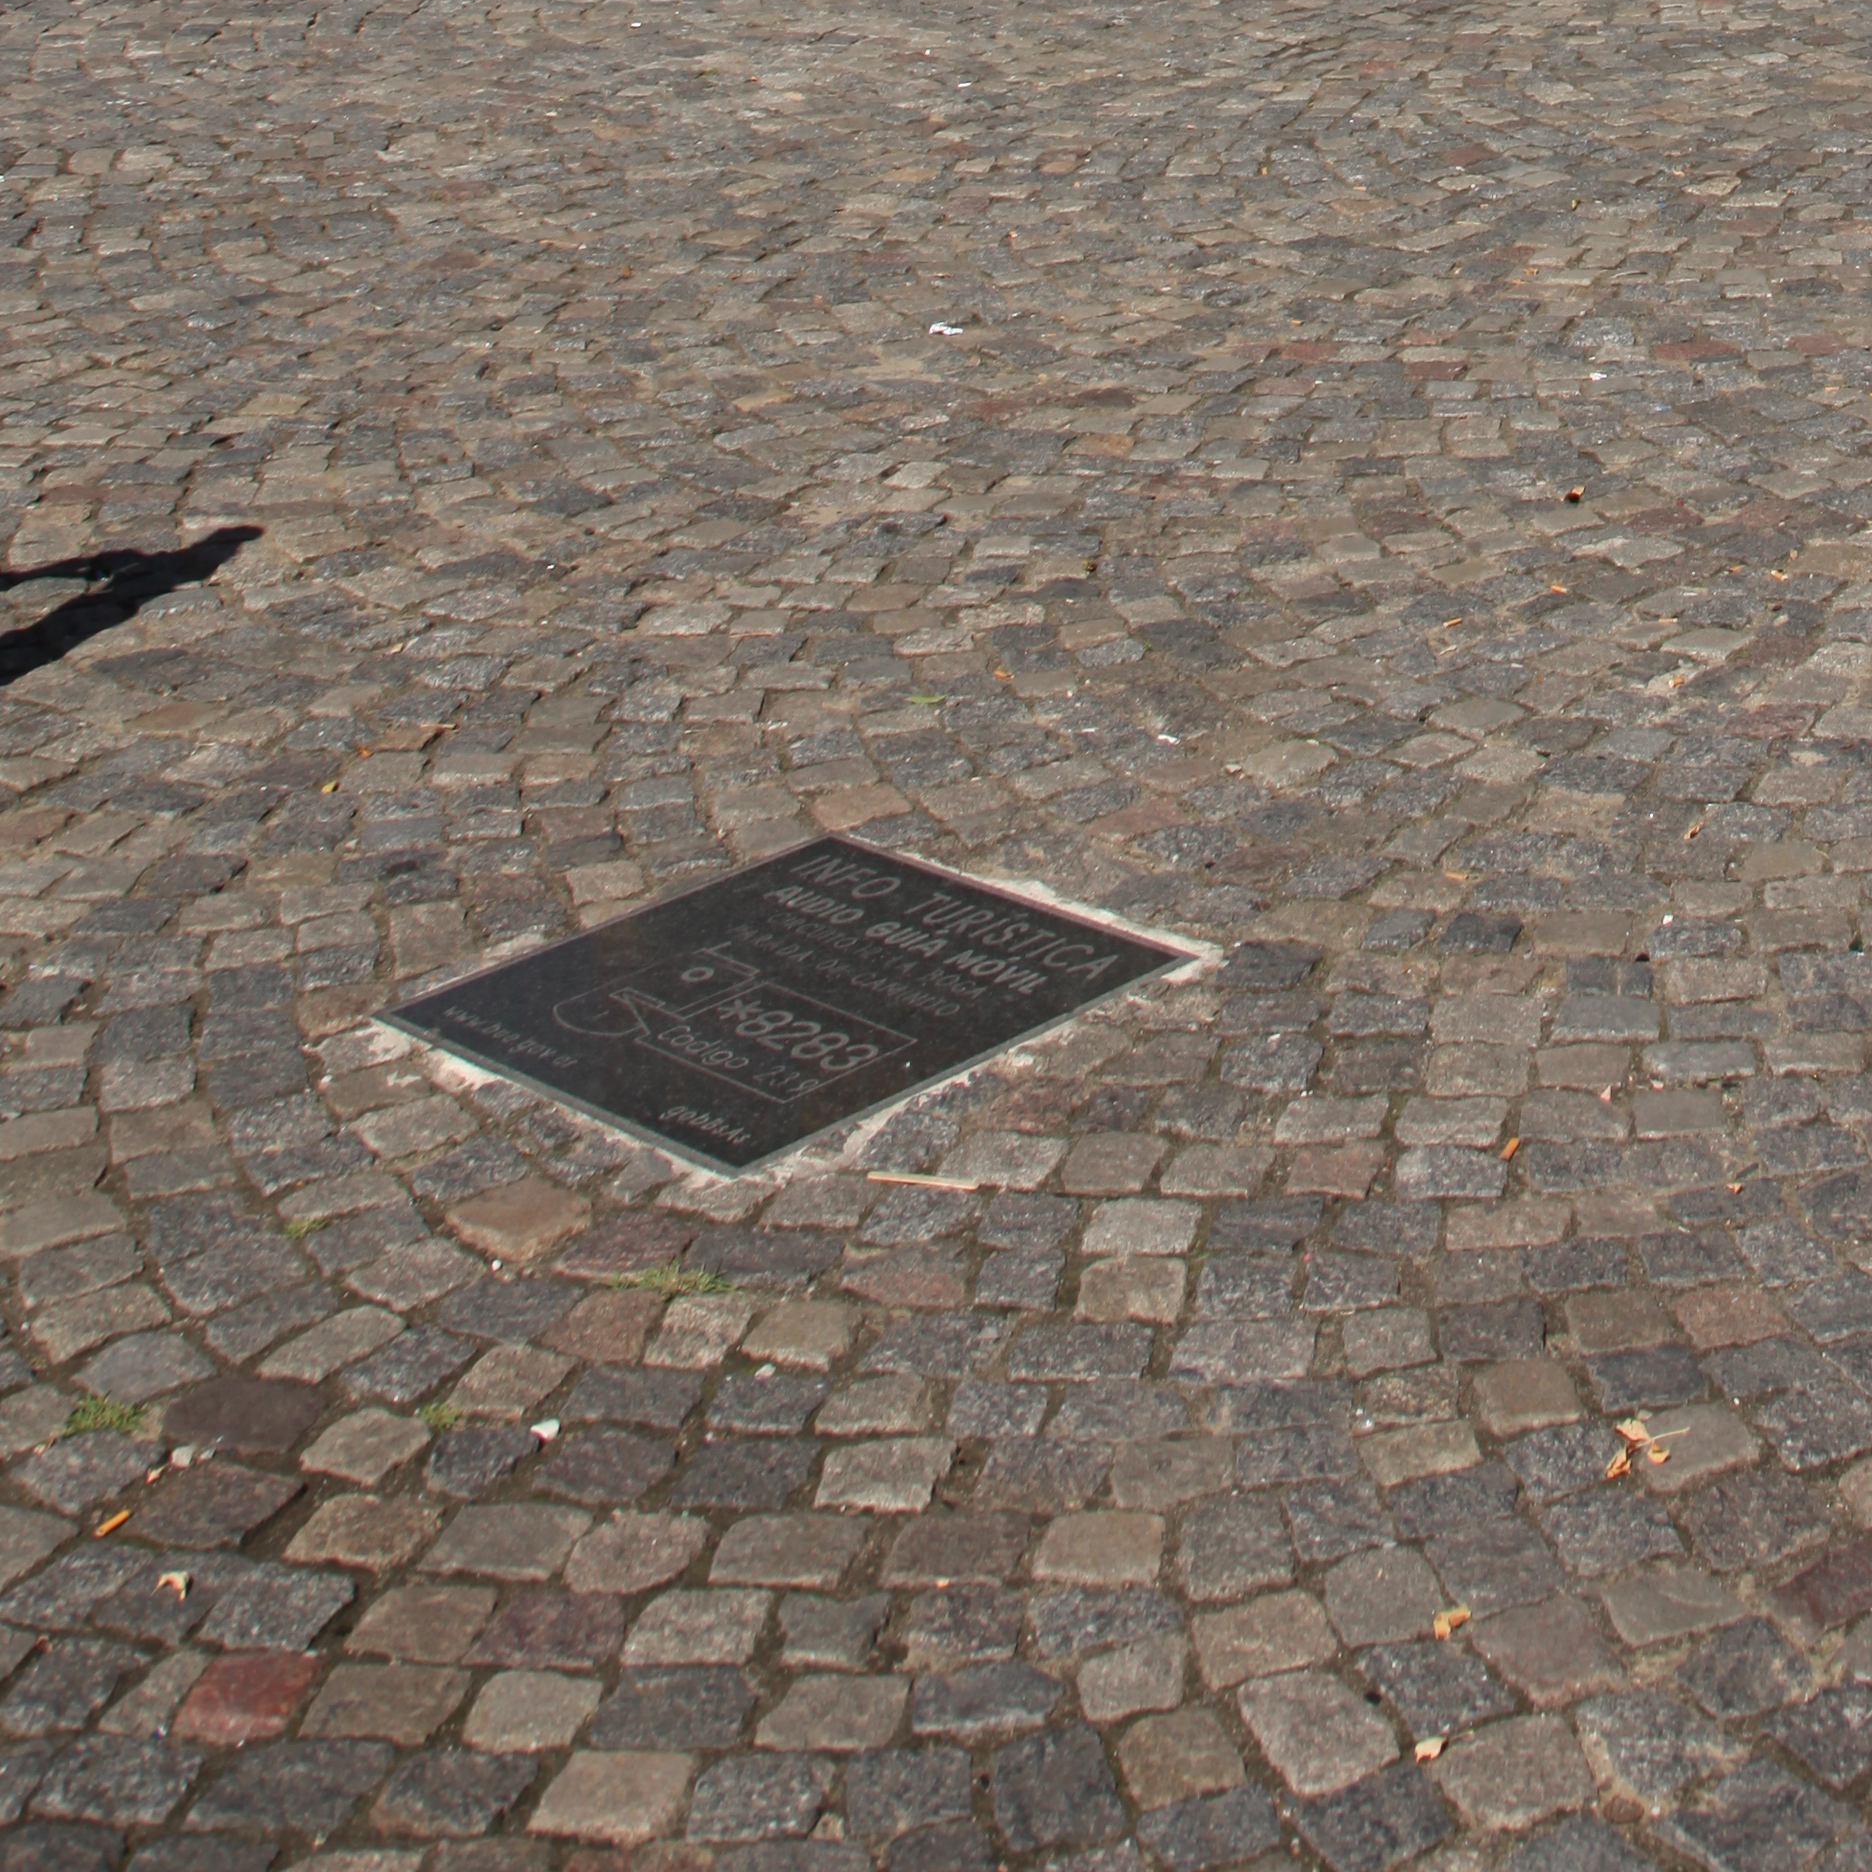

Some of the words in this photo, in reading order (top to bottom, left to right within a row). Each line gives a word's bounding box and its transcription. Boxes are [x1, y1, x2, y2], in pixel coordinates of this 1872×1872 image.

[763, 885, 864, 924] AUDIO
[864, 920, 949, 957] GUÍA
[943, 949, 1047, 994] MÓVIL
[790, 854, 901, 898] INFO
[904, 891, 1117, 979] TURÍSTICA
